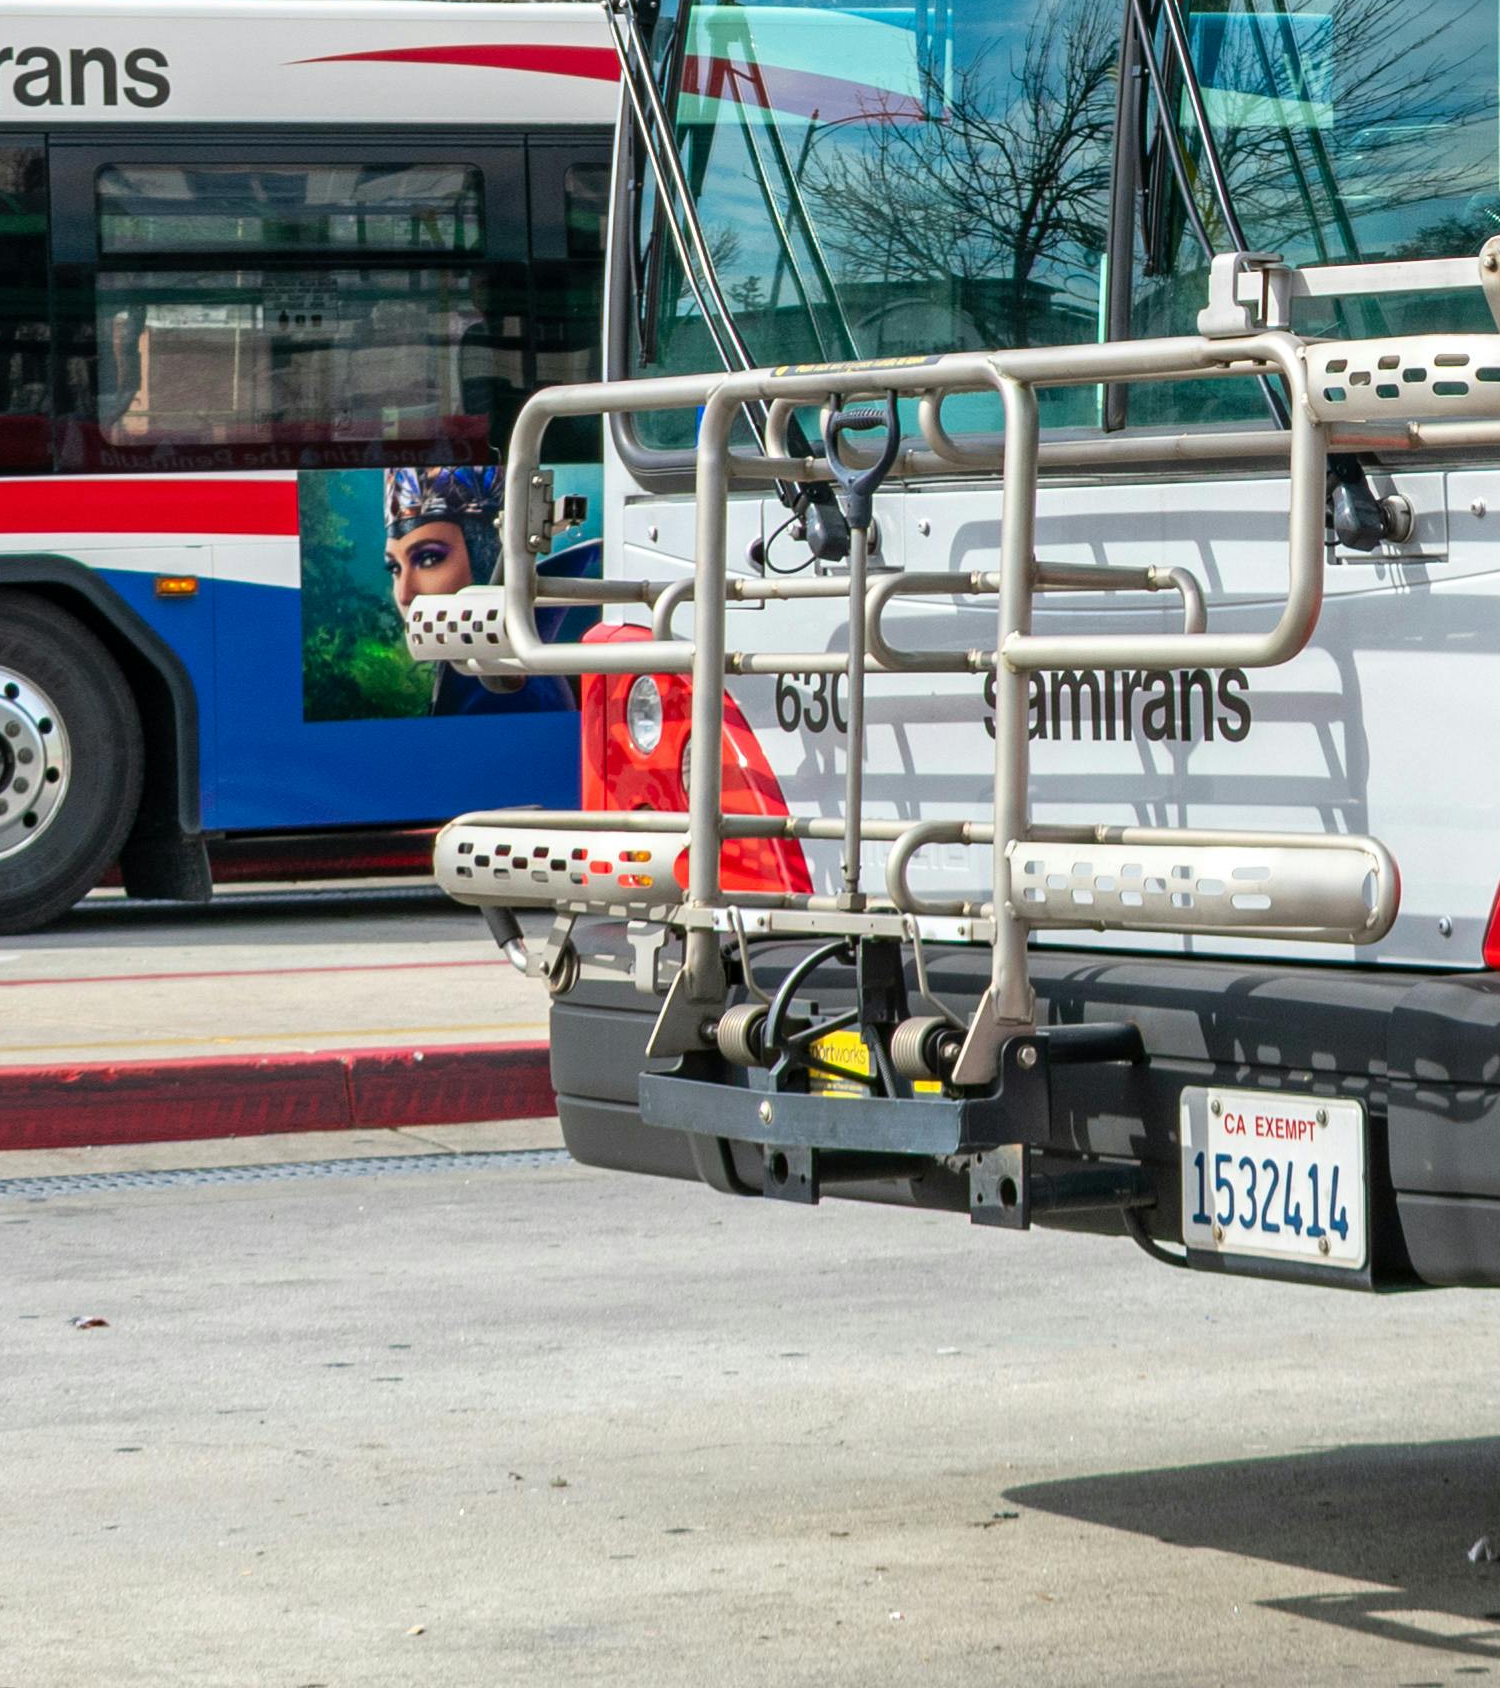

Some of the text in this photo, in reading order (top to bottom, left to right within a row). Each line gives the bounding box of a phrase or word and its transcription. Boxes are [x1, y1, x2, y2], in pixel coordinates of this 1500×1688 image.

[810, 1044, 866, 1066] portworks
[1224, 1113, 1316, 1142] CA EXEMPT
[1192, 1150, 1348, 1241] 1532414
